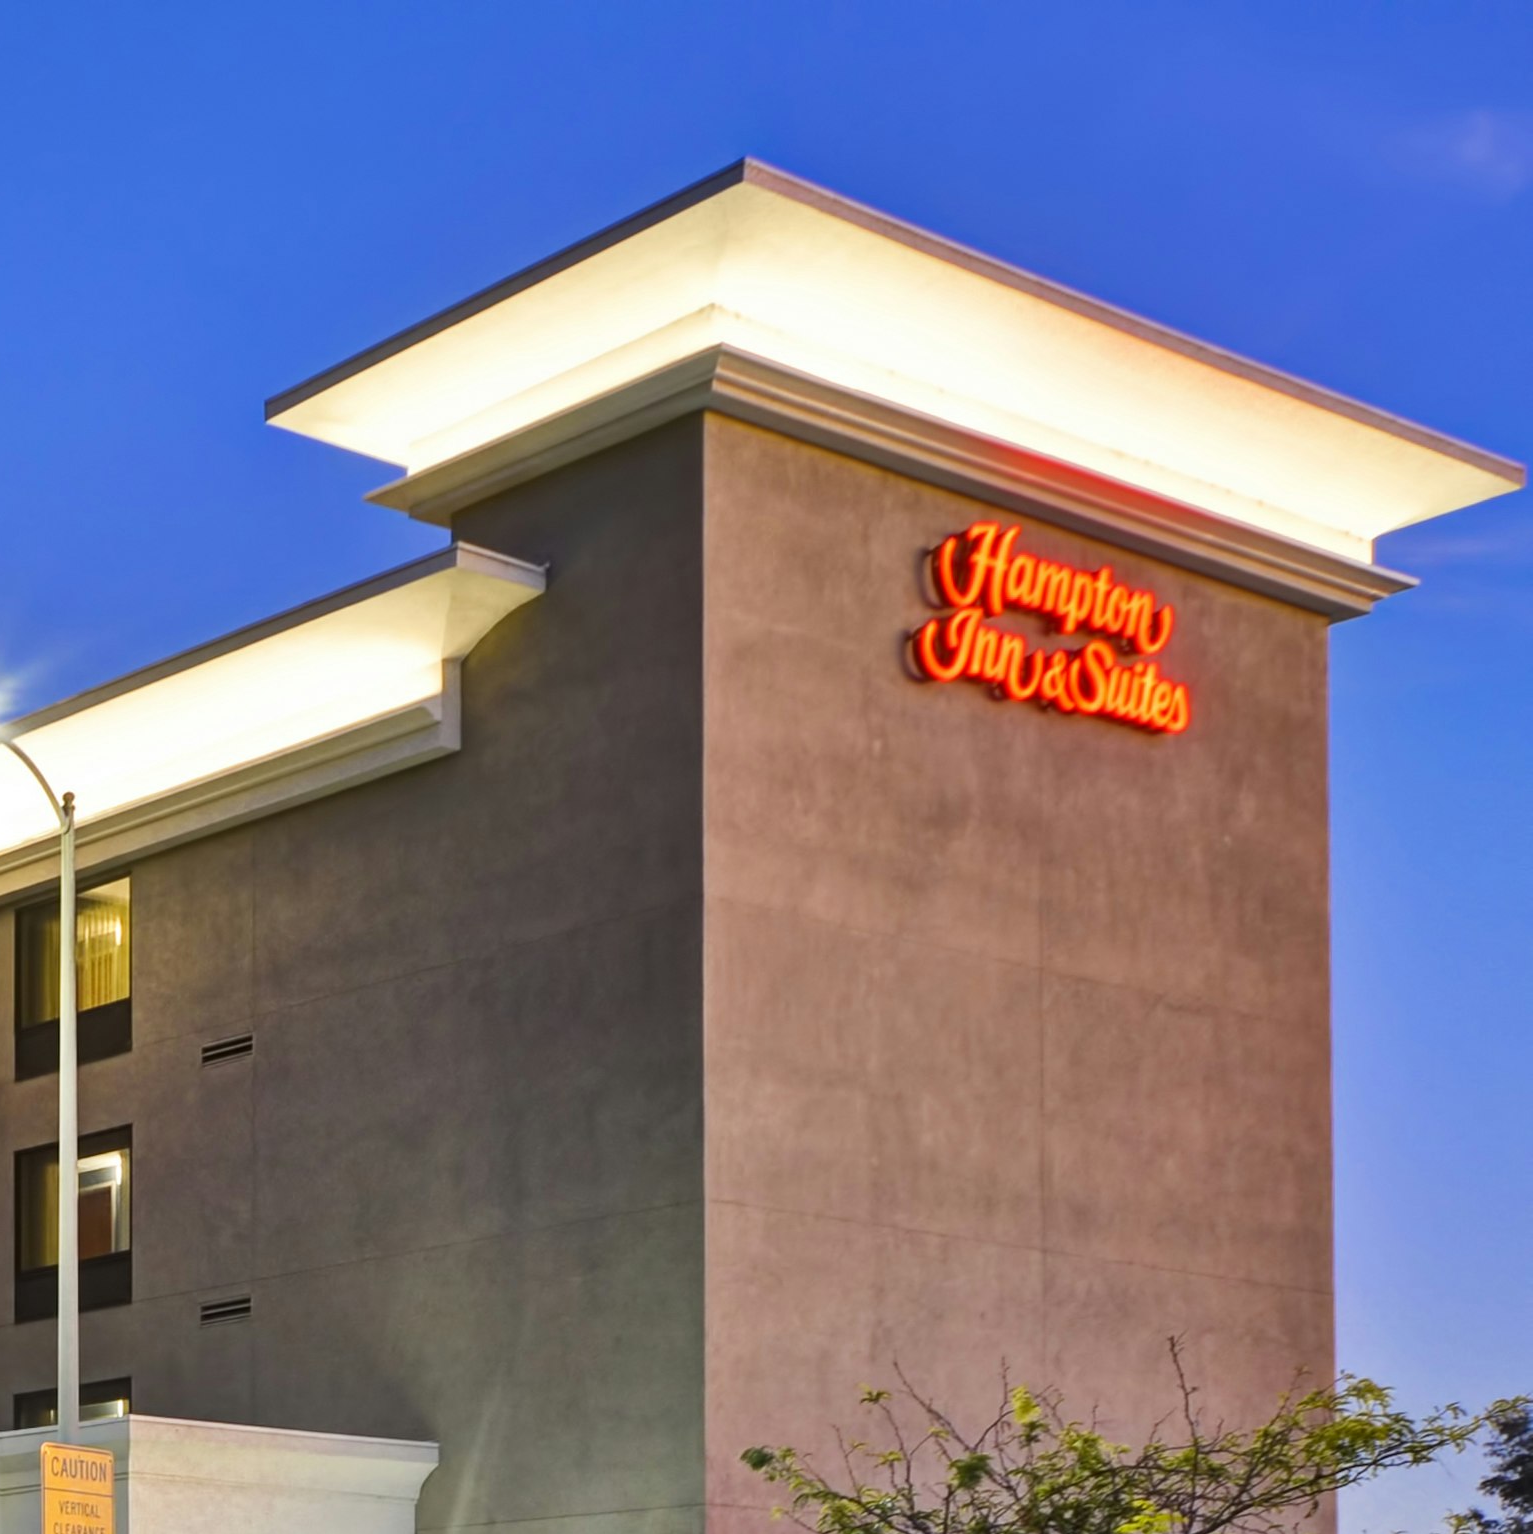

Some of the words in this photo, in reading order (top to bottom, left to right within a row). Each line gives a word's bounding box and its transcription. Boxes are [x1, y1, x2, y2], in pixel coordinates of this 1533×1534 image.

[937, 520, 1174, 655] Hampton
[917, 606, 1046, 701] Inn
[1041, 650, 1076, 711] &
[1070, 638, 1191, 734] Suites
[51, 1456, 107, 1483] CAUTION
[59, 1500, 101, 1519] VERTICAL
